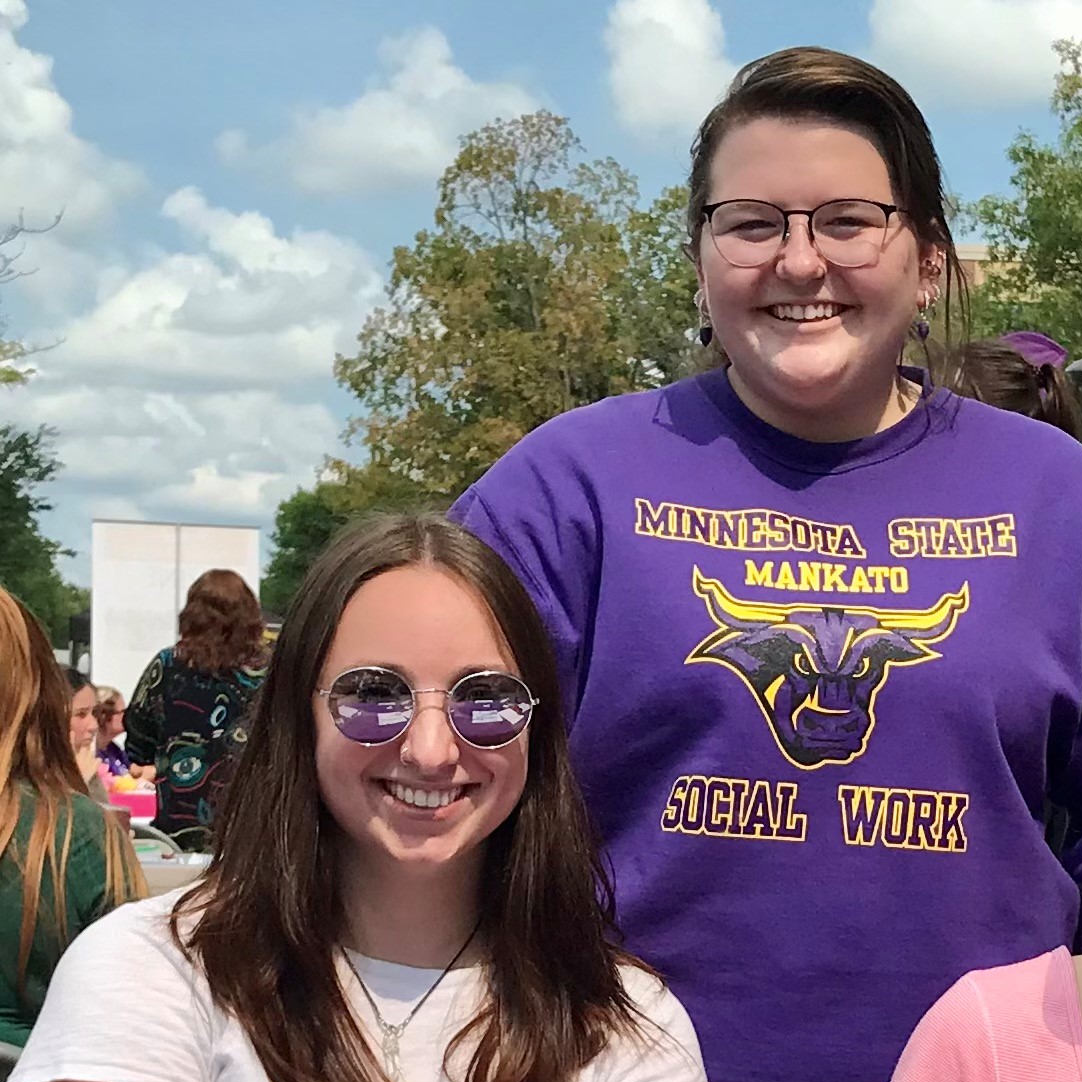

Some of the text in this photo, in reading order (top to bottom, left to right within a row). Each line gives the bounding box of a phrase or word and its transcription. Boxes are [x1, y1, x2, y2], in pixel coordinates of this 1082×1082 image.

[635, 498, 1017, 558] MINNESOTA STATE
[744, 560, 909, 594] MANKATO
[661, 775, 969, 852] SOCIAL WORK
